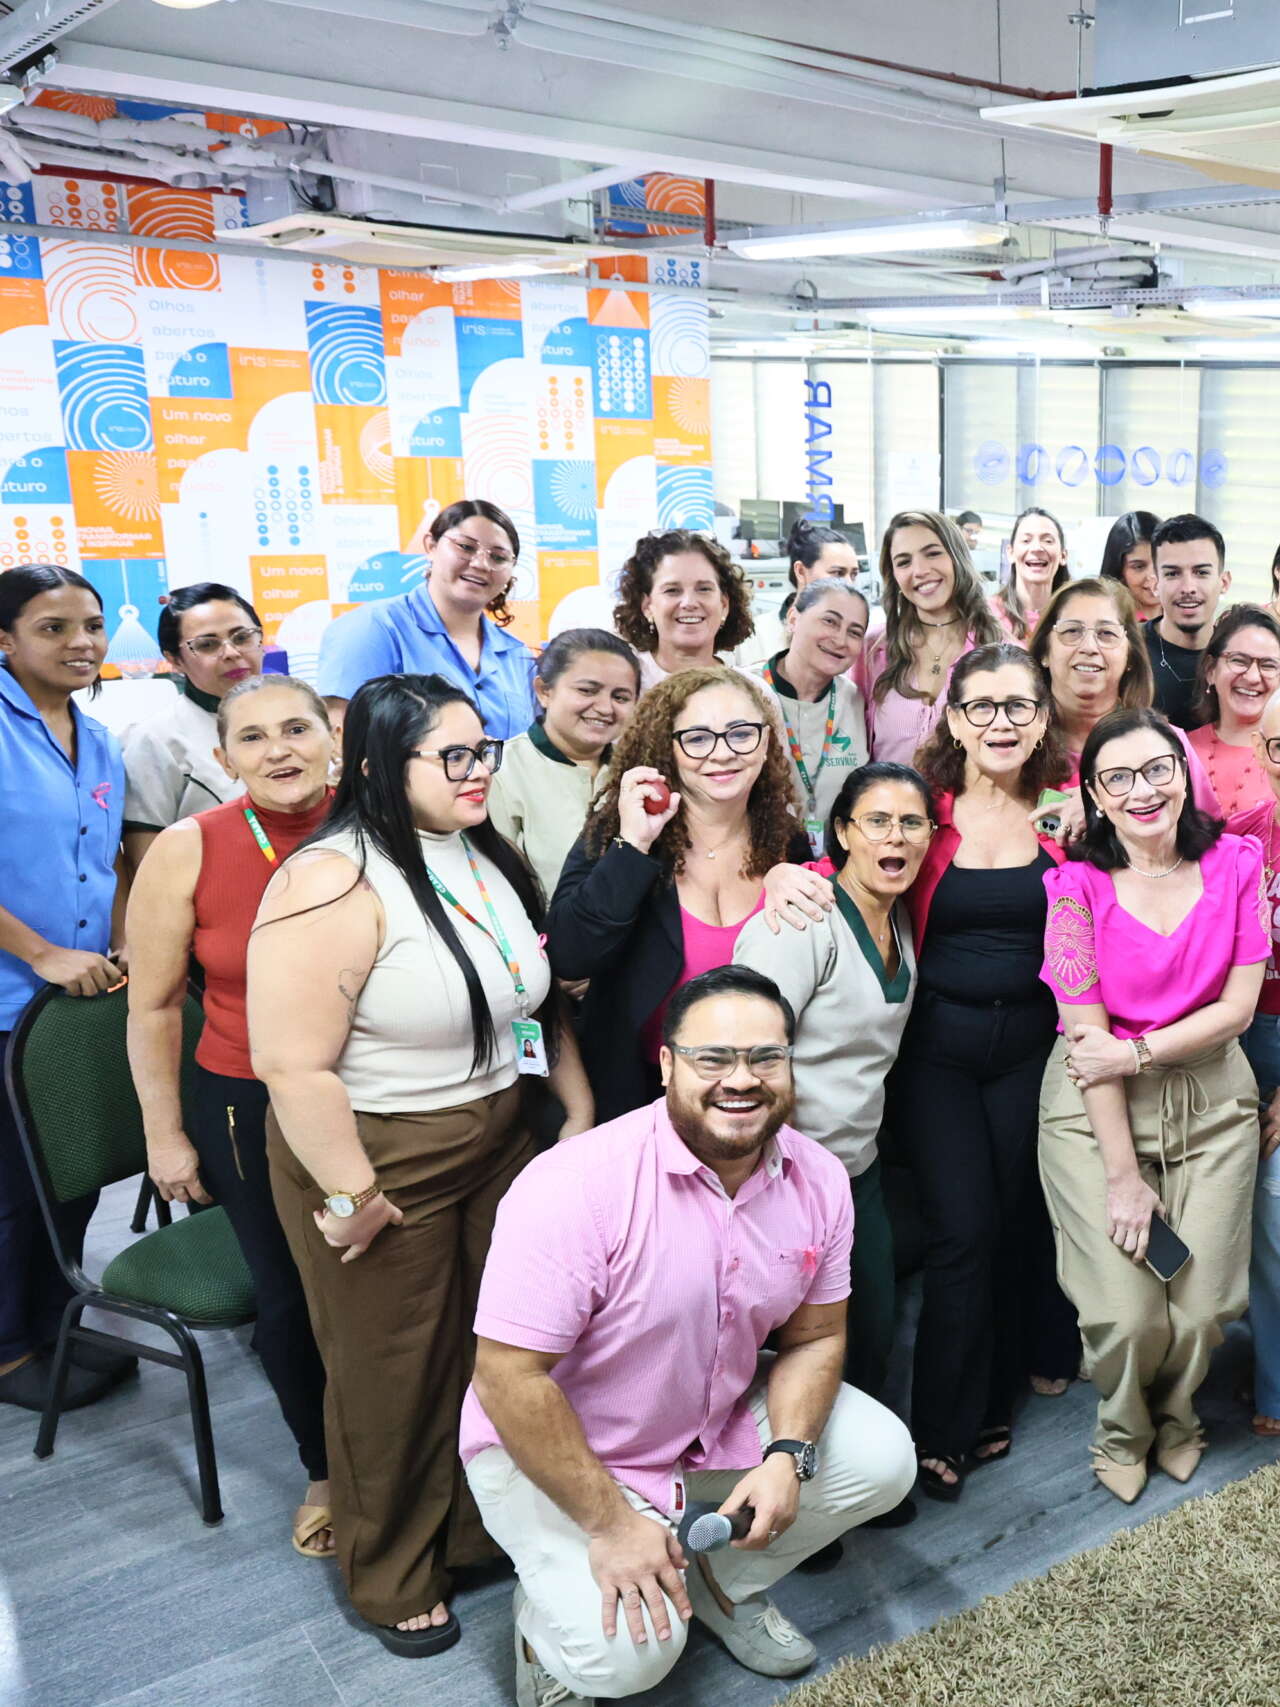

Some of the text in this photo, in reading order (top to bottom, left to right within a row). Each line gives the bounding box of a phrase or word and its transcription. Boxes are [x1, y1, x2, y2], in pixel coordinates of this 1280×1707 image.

[388, 290, 425, 302] olhar
[148, 299, 195, 312] Olhos
[152, 326, 216, 339] abertos
[562, 324, 573, 335] o
[155, 350, 207, 364] para o
[239, 352, 266, 368] iris
[162, 409, 232, 422] Um novo
[433, 415, 443, 425] o
[164, 433, 206, 445] olhar
[31, 457, 43, 468] o
[260, 566, 325, 577] Um novo
[370, 560, 382, 571] o
[262, 588, 301, 600] olhar
